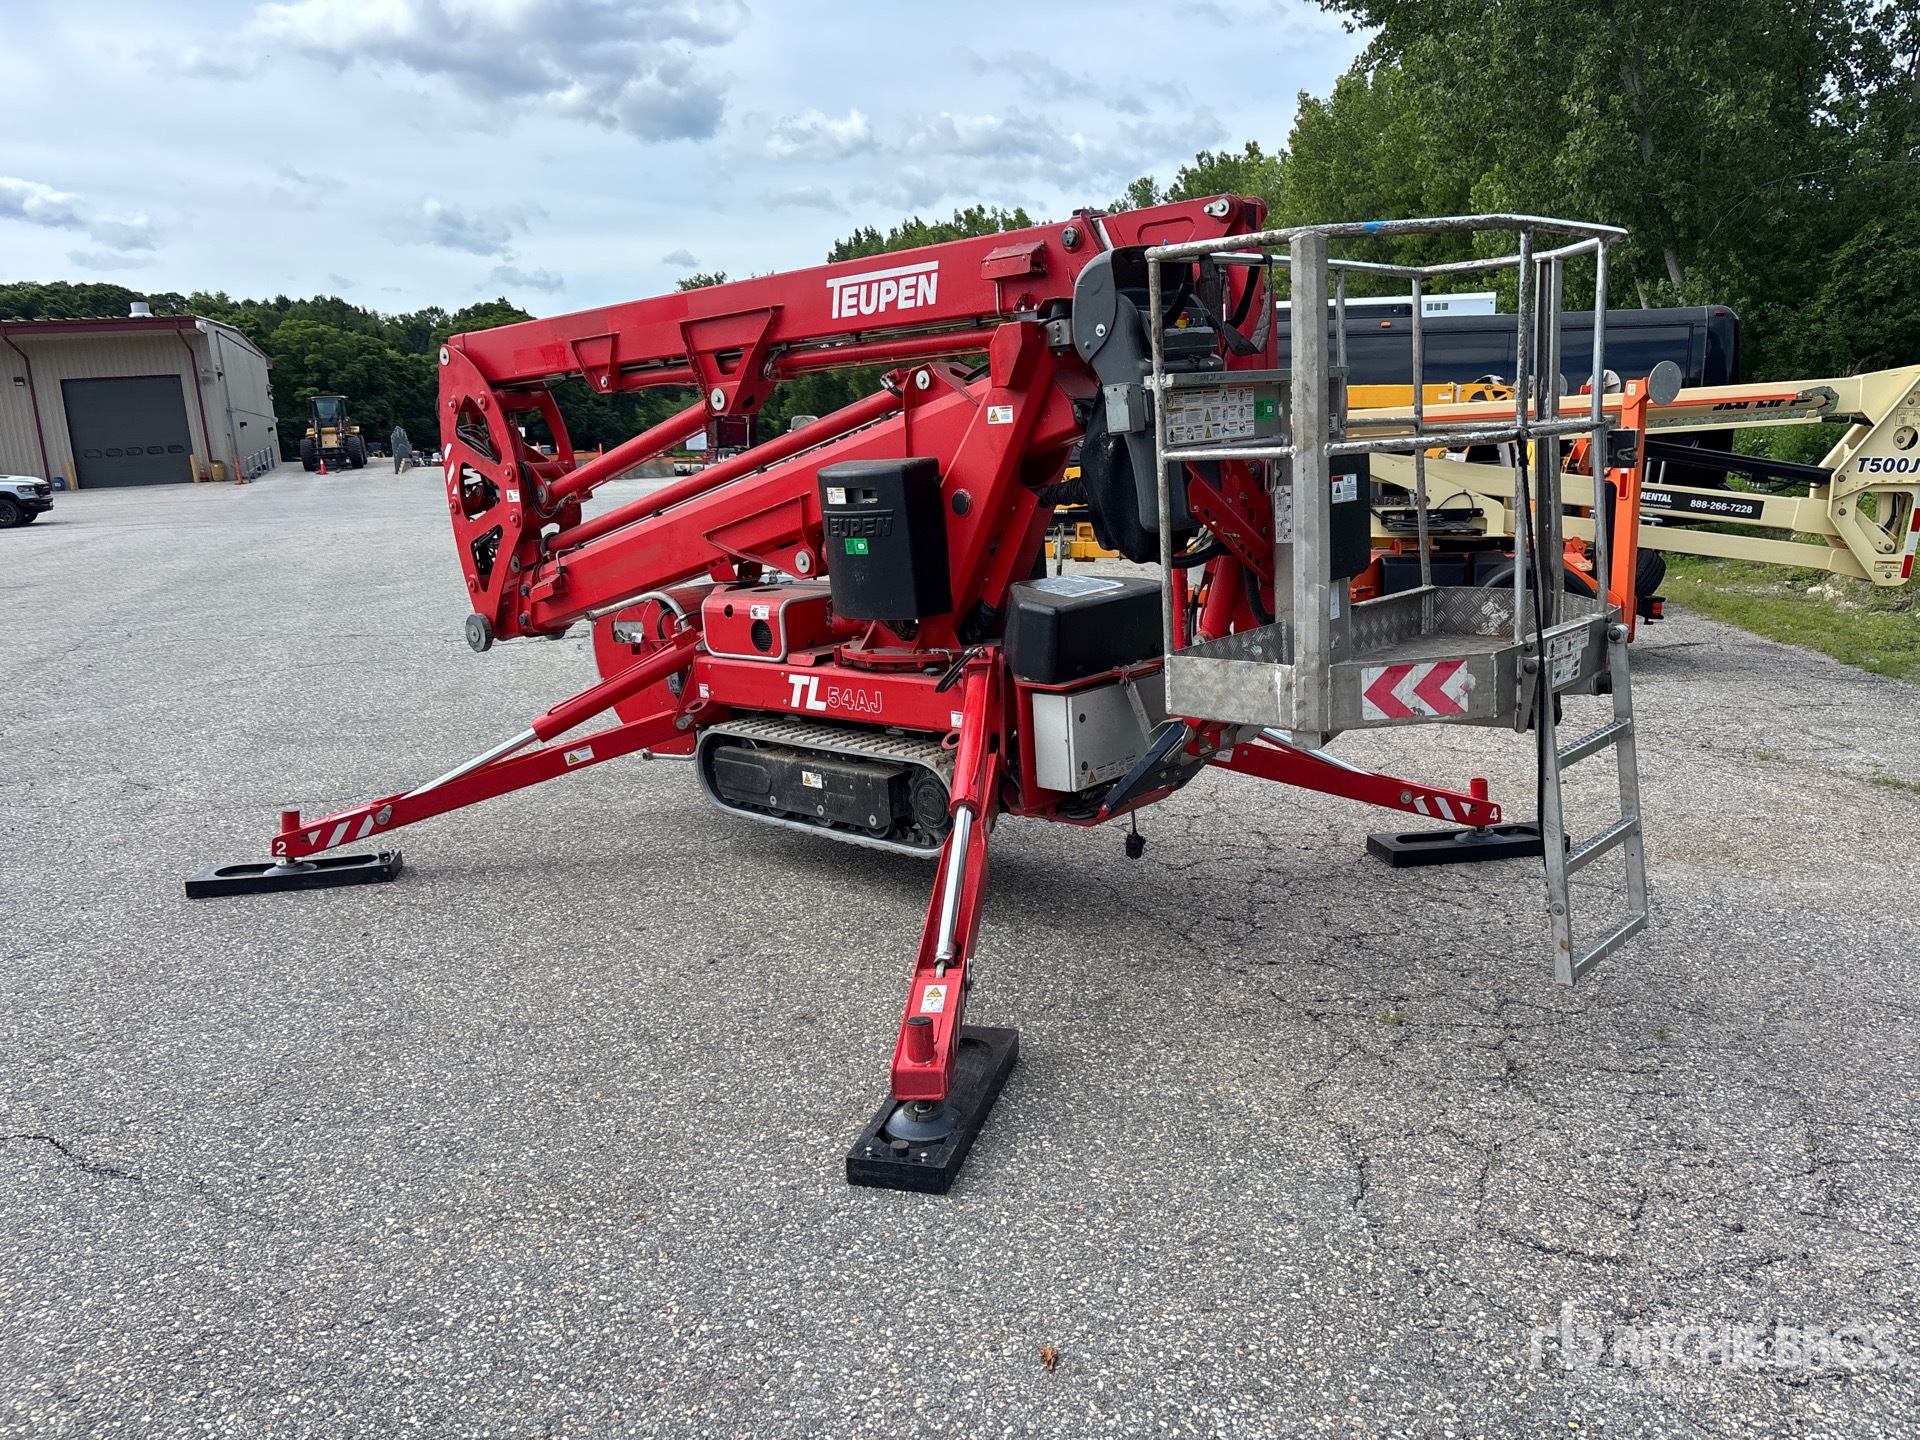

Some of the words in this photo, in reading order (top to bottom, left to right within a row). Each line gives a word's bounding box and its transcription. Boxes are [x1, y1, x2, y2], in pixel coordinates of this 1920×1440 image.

[826, 260, 939, 319] TEUPEN
[1640, 491, 1673, 503] RENTAL
[1690, 499, 1753, 514] 888-266-7228
[824, 509, 894, 537] TEUPEN
[1489, 806, 1499, 821] 4
[276, 841, 287, 855] 2
